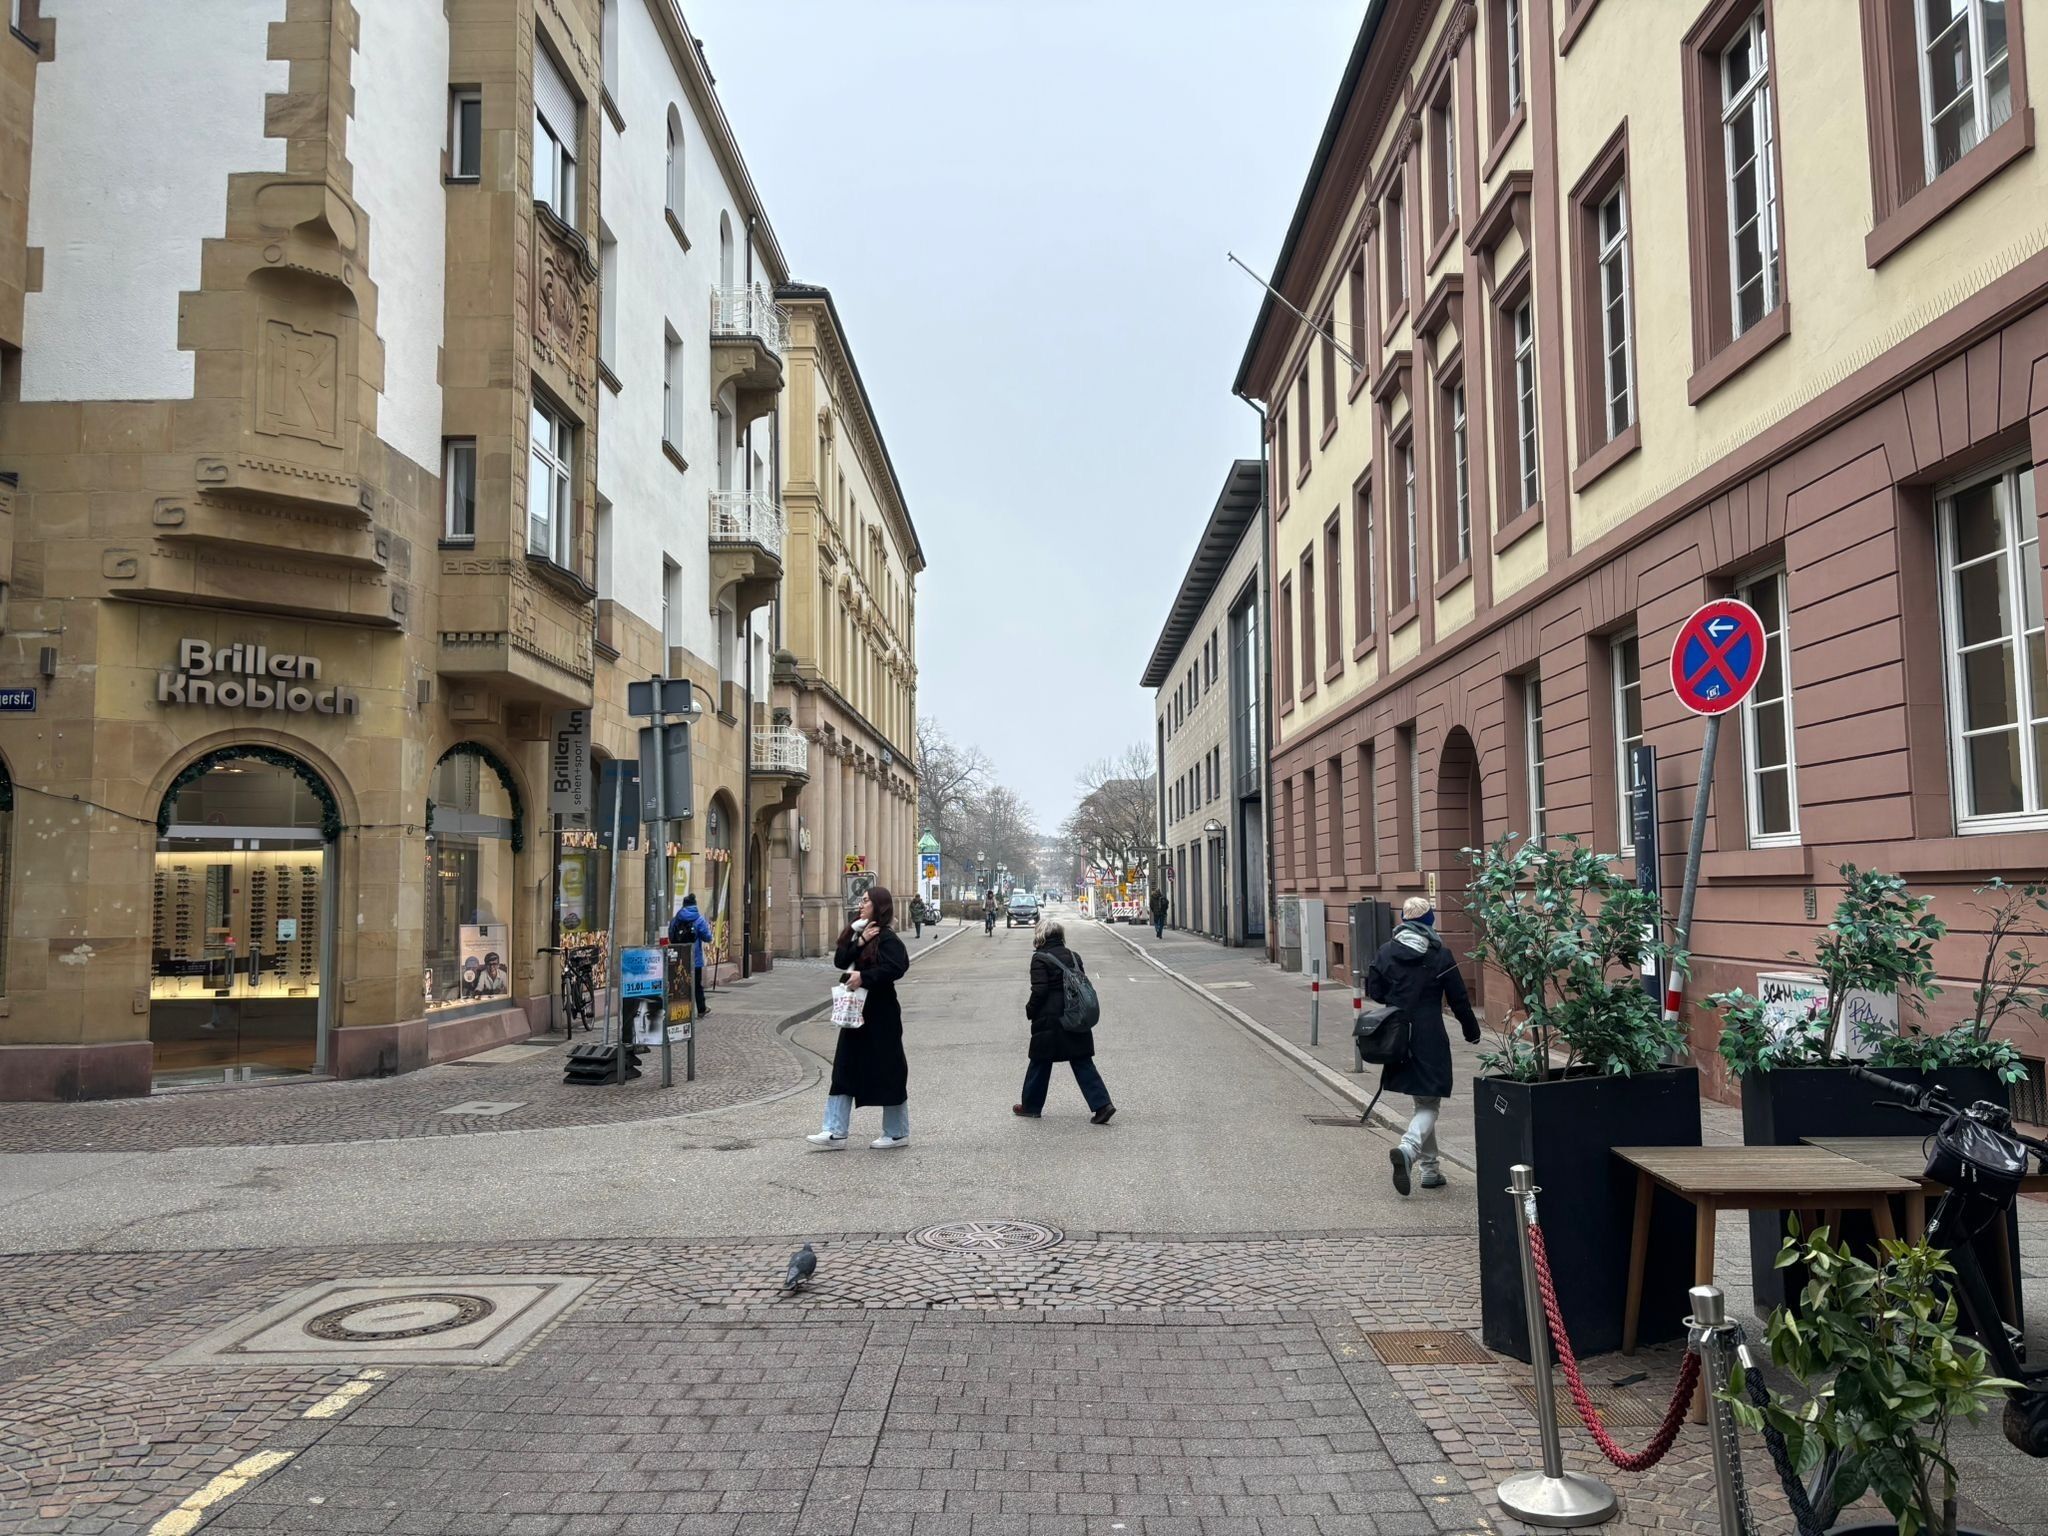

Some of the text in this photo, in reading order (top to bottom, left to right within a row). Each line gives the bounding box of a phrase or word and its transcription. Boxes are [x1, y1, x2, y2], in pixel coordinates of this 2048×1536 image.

[180, 638, 321, 680] Brillen
[0, 691, 31, 706] erstr.
[157, 671, 361, 715] Knobloch
[553, 731, 571, 793] Brillen
[571, 740, 584, 806] sehen+sport
